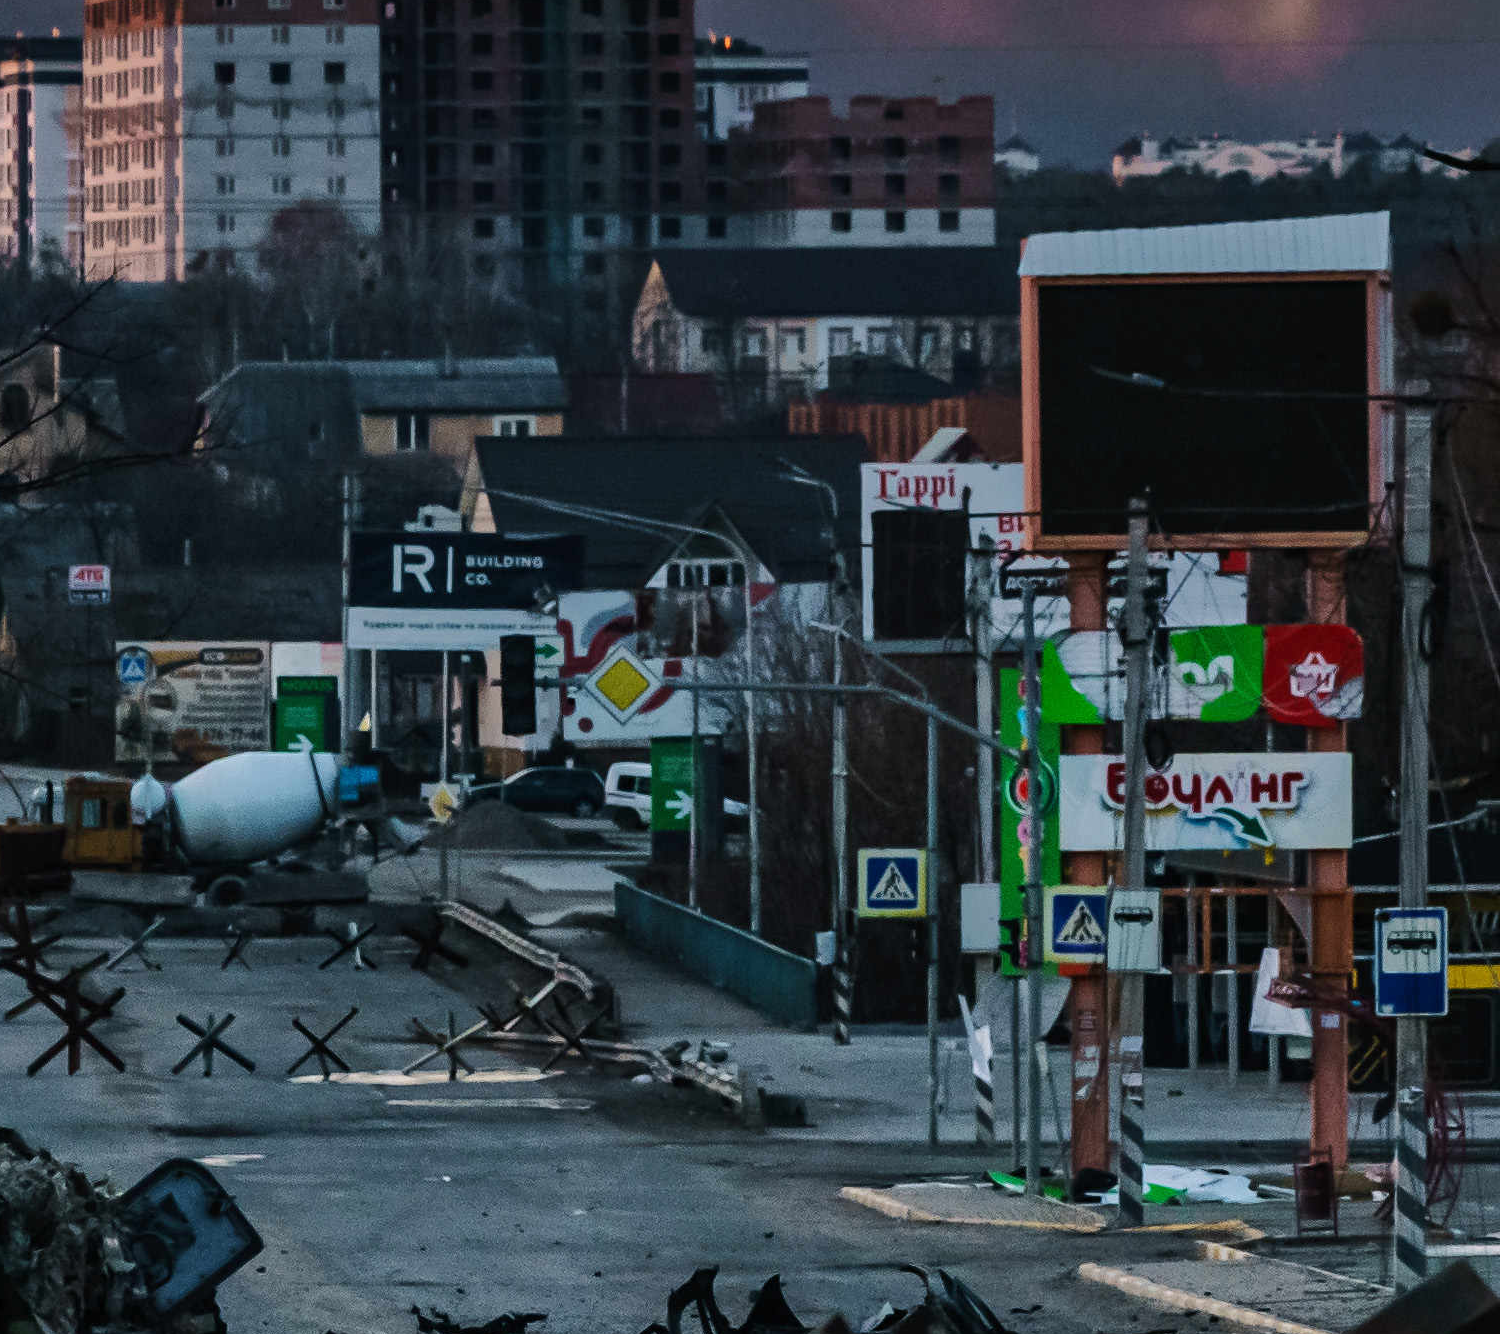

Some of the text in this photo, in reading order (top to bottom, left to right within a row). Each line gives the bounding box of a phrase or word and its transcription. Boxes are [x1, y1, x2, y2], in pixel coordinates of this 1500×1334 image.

[875, 468, 956, 509] Гаррі
[464, 554, 544, 569] BUILDING
[1106, 762, 1304, 813] Боулнг
